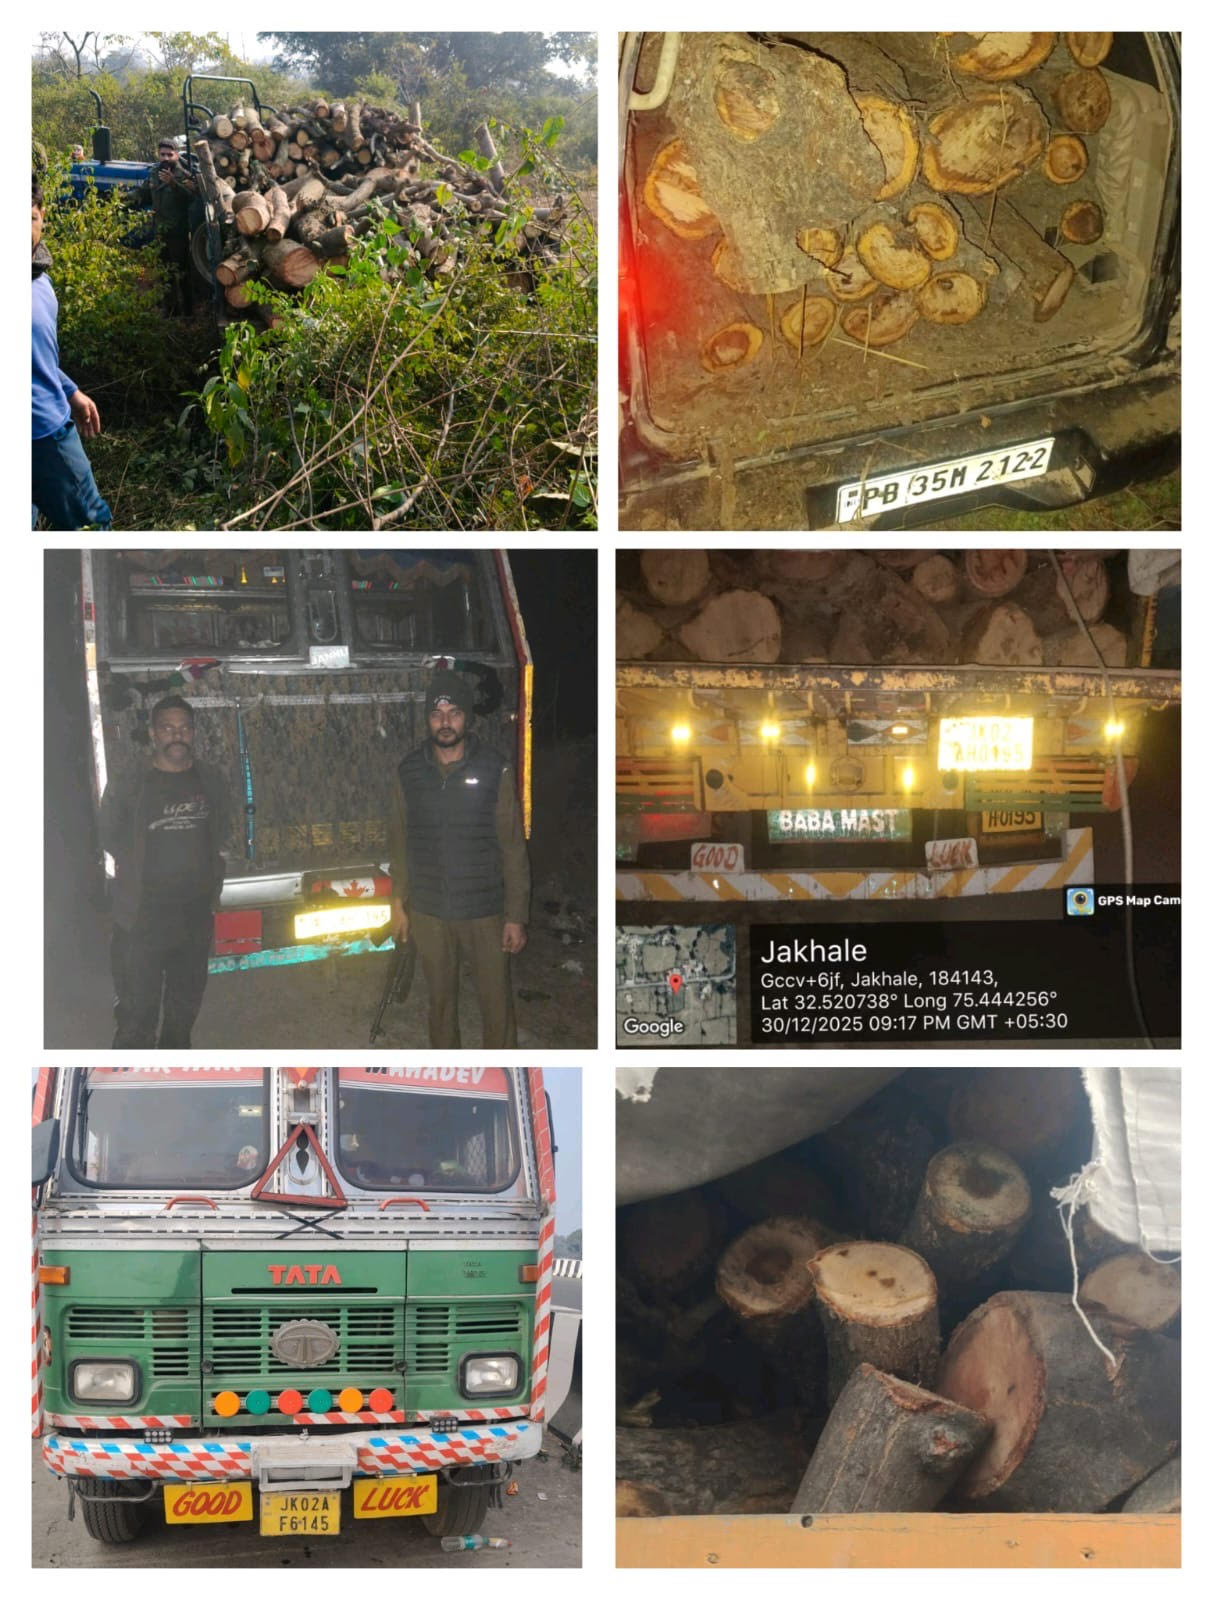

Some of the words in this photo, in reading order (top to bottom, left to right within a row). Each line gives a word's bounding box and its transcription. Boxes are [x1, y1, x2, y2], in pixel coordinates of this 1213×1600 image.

[863, 482, 898, 510] PB
[977, 447, 1047, 482] 2122
[780, 809, 835, 832] BABA
[841, 809, 897, 836] MAST
[693, 845, 738, 870] GOOD
[268, 1264, 342, 1285] TATA
[172, 1490, 243, 1516] GOOD
[280, 1496, 330, 1512] JK02A
[361, 1484, 430, 1512] LUCK
[279, 1515, 330, 1532] F6145
